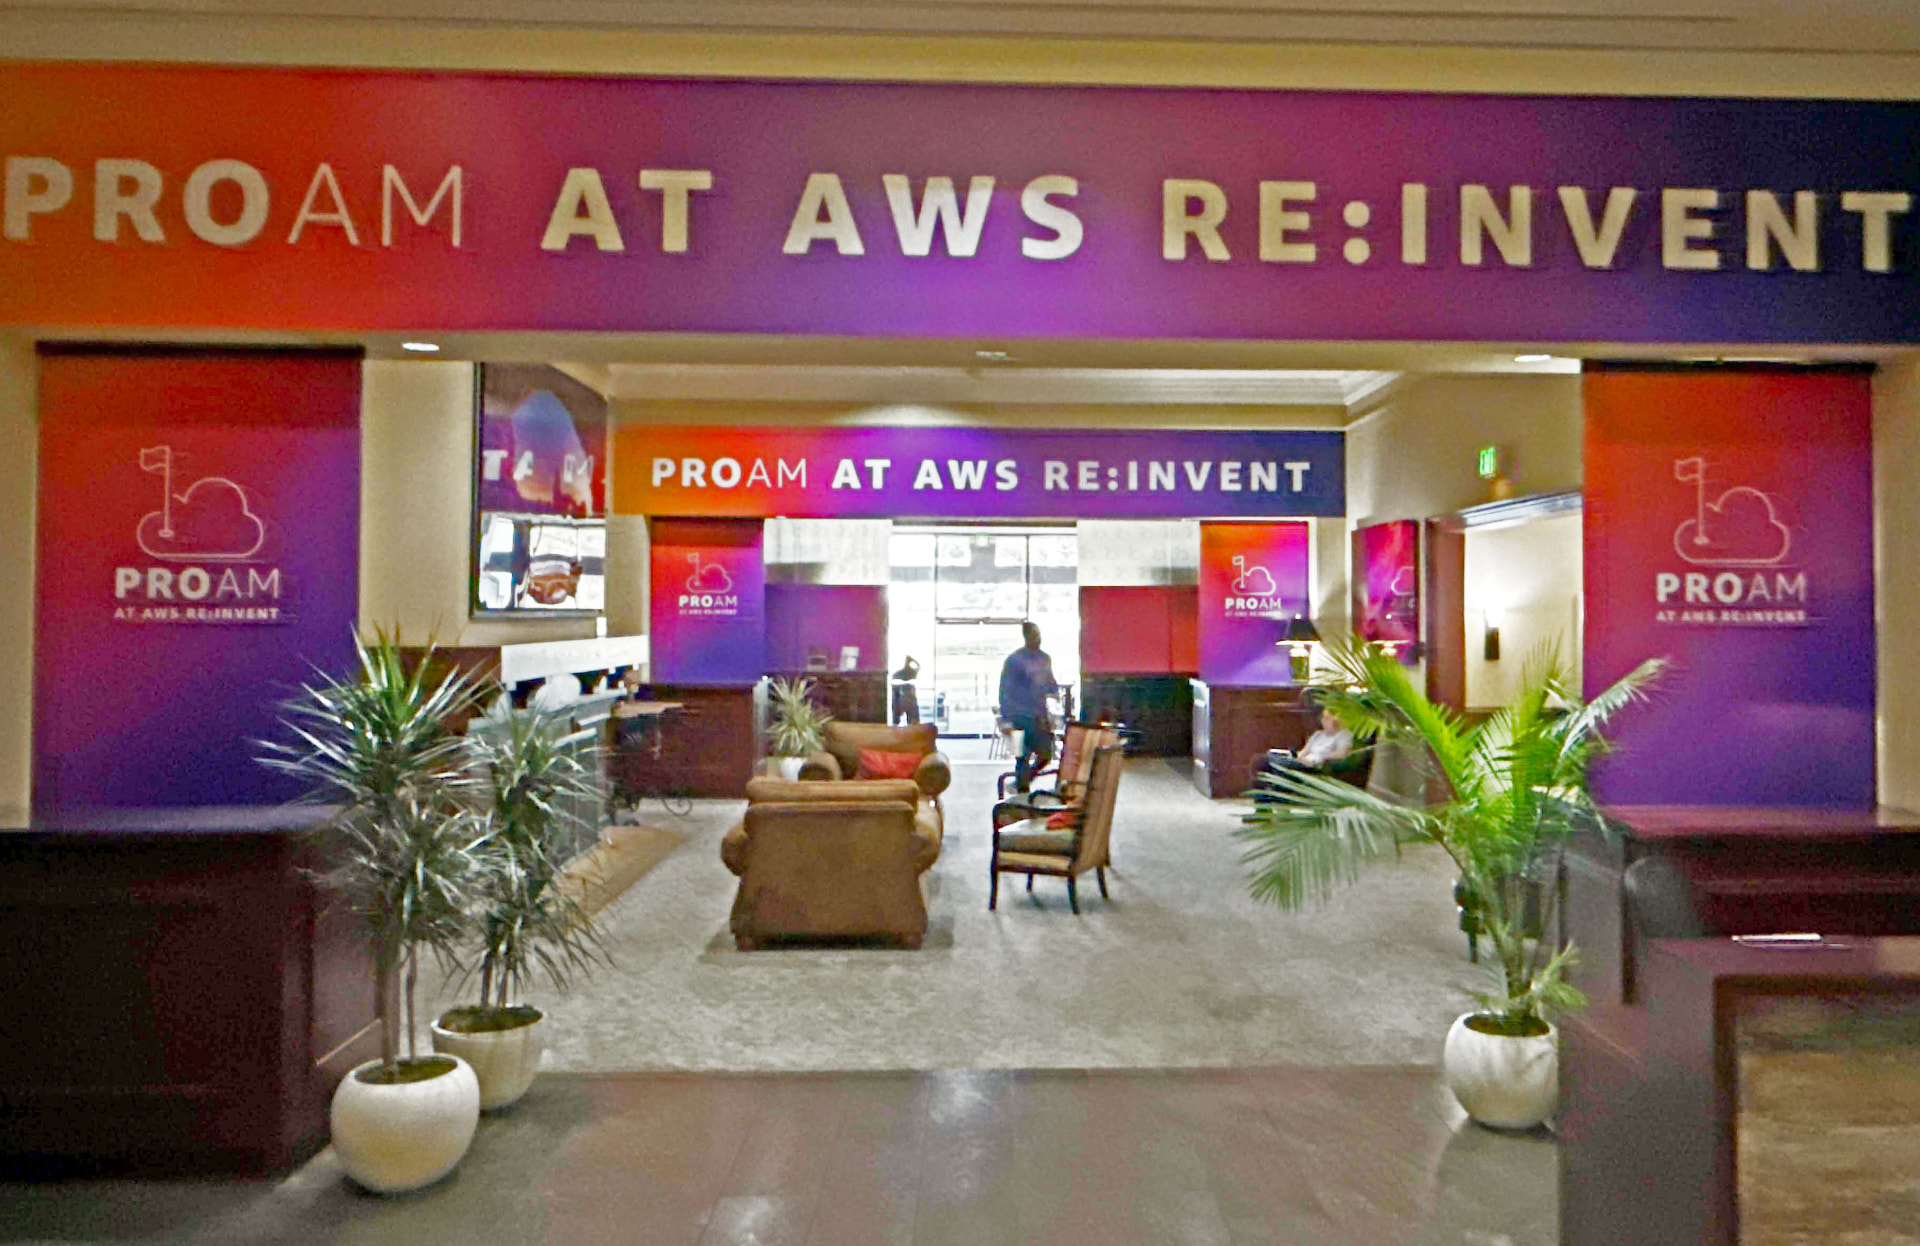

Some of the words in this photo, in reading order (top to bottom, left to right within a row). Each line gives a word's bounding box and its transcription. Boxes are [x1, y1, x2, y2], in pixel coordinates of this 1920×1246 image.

[4, 157, 463, 247] PROAM
[540, 167, 714, 253] AT
[783, 172, 1085, 260] AWS
[1162, 178, 1912, 274] RE:INVENT
[651, 457, 807, 489] PROAM
[832, 459, 891, 490] AT
[913, 459, 1018, 491] AWS
[1044, 460, 1311, 494] RE:INVENT
[115, 567, 280, 600] PROAM
[1656, 572, 1808, 603] PROAM
[678, 595, 738, 608] PROAM
[1225, 597, 1282, 610] PROAM
[114, 607, 135, 619] AT
[142, 607, 179, 619] AWS
[1656, 610, 1676, 622] AT
